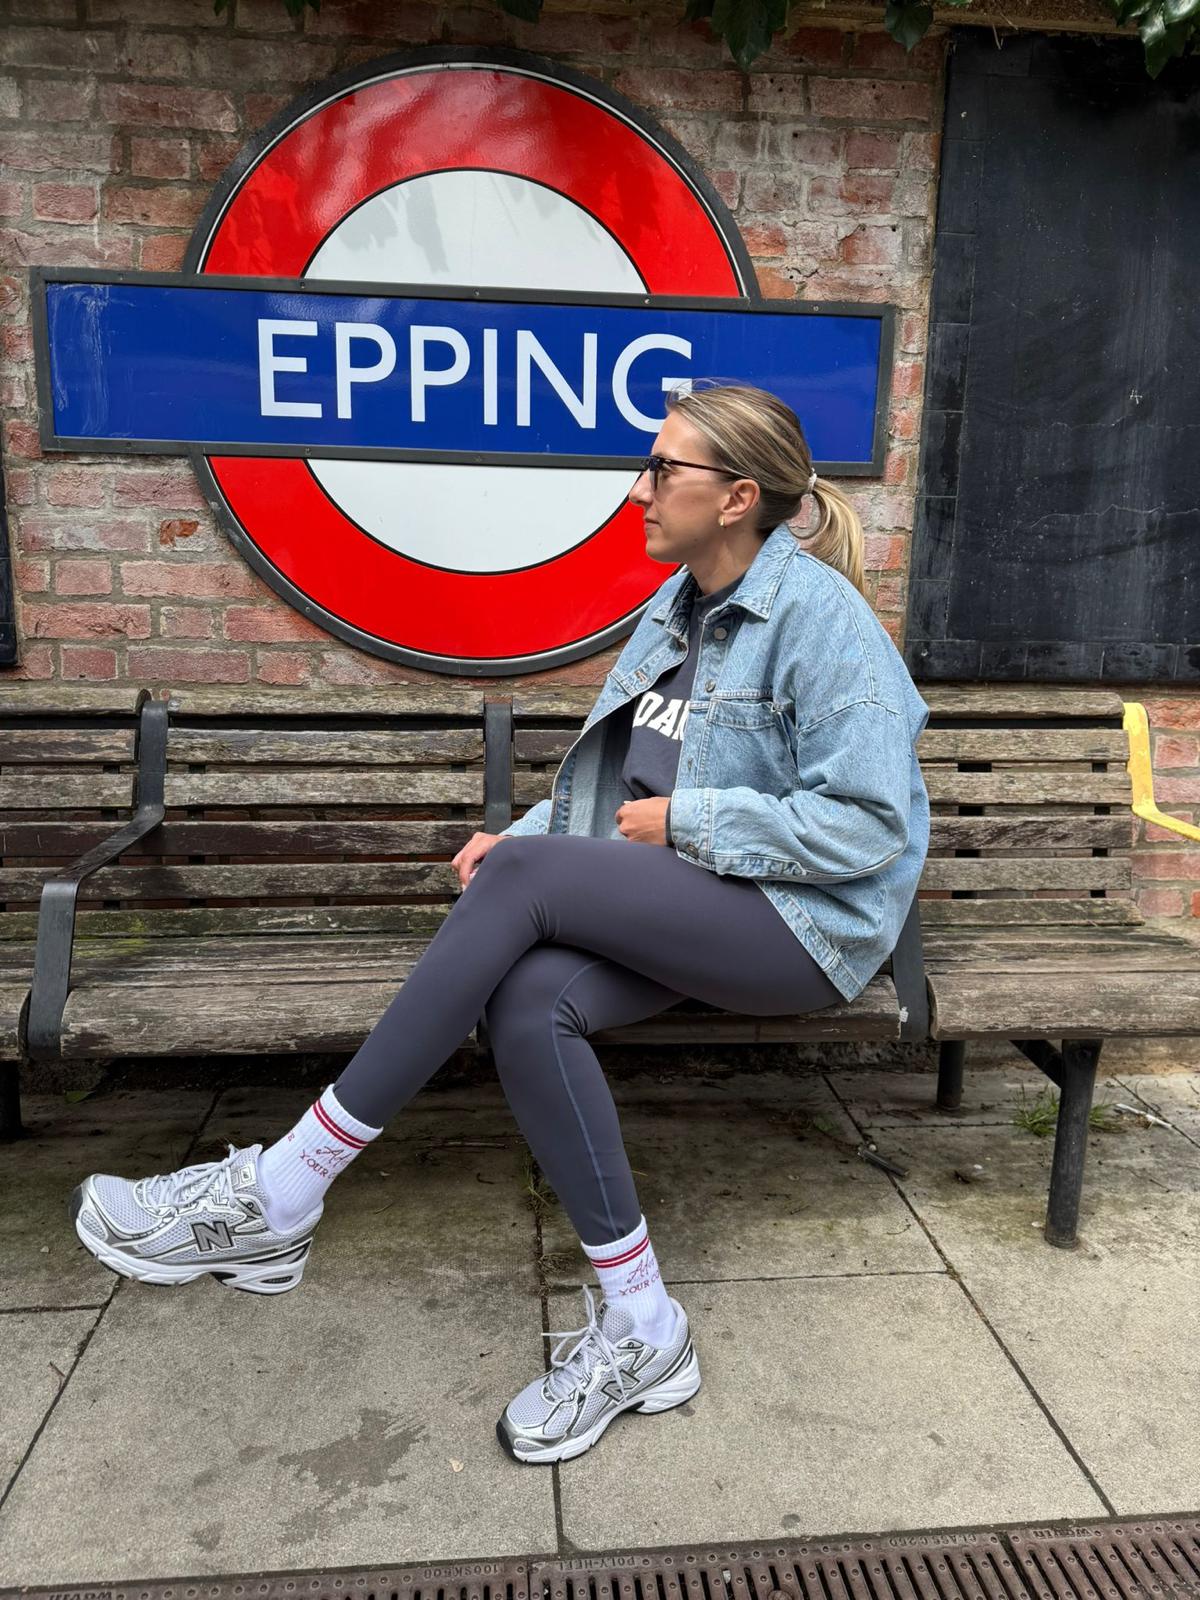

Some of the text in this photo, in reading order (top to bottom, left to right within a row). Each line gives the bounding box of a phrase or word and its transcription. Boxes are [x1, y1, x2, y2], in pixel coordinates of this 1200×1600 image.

[257, 318, 693, 433] EPPING
[299, 1149, 329, 1177] YOUR
[191, 1220, 234, 1252] N
[619, 1280, 650, 1297] YOUR
